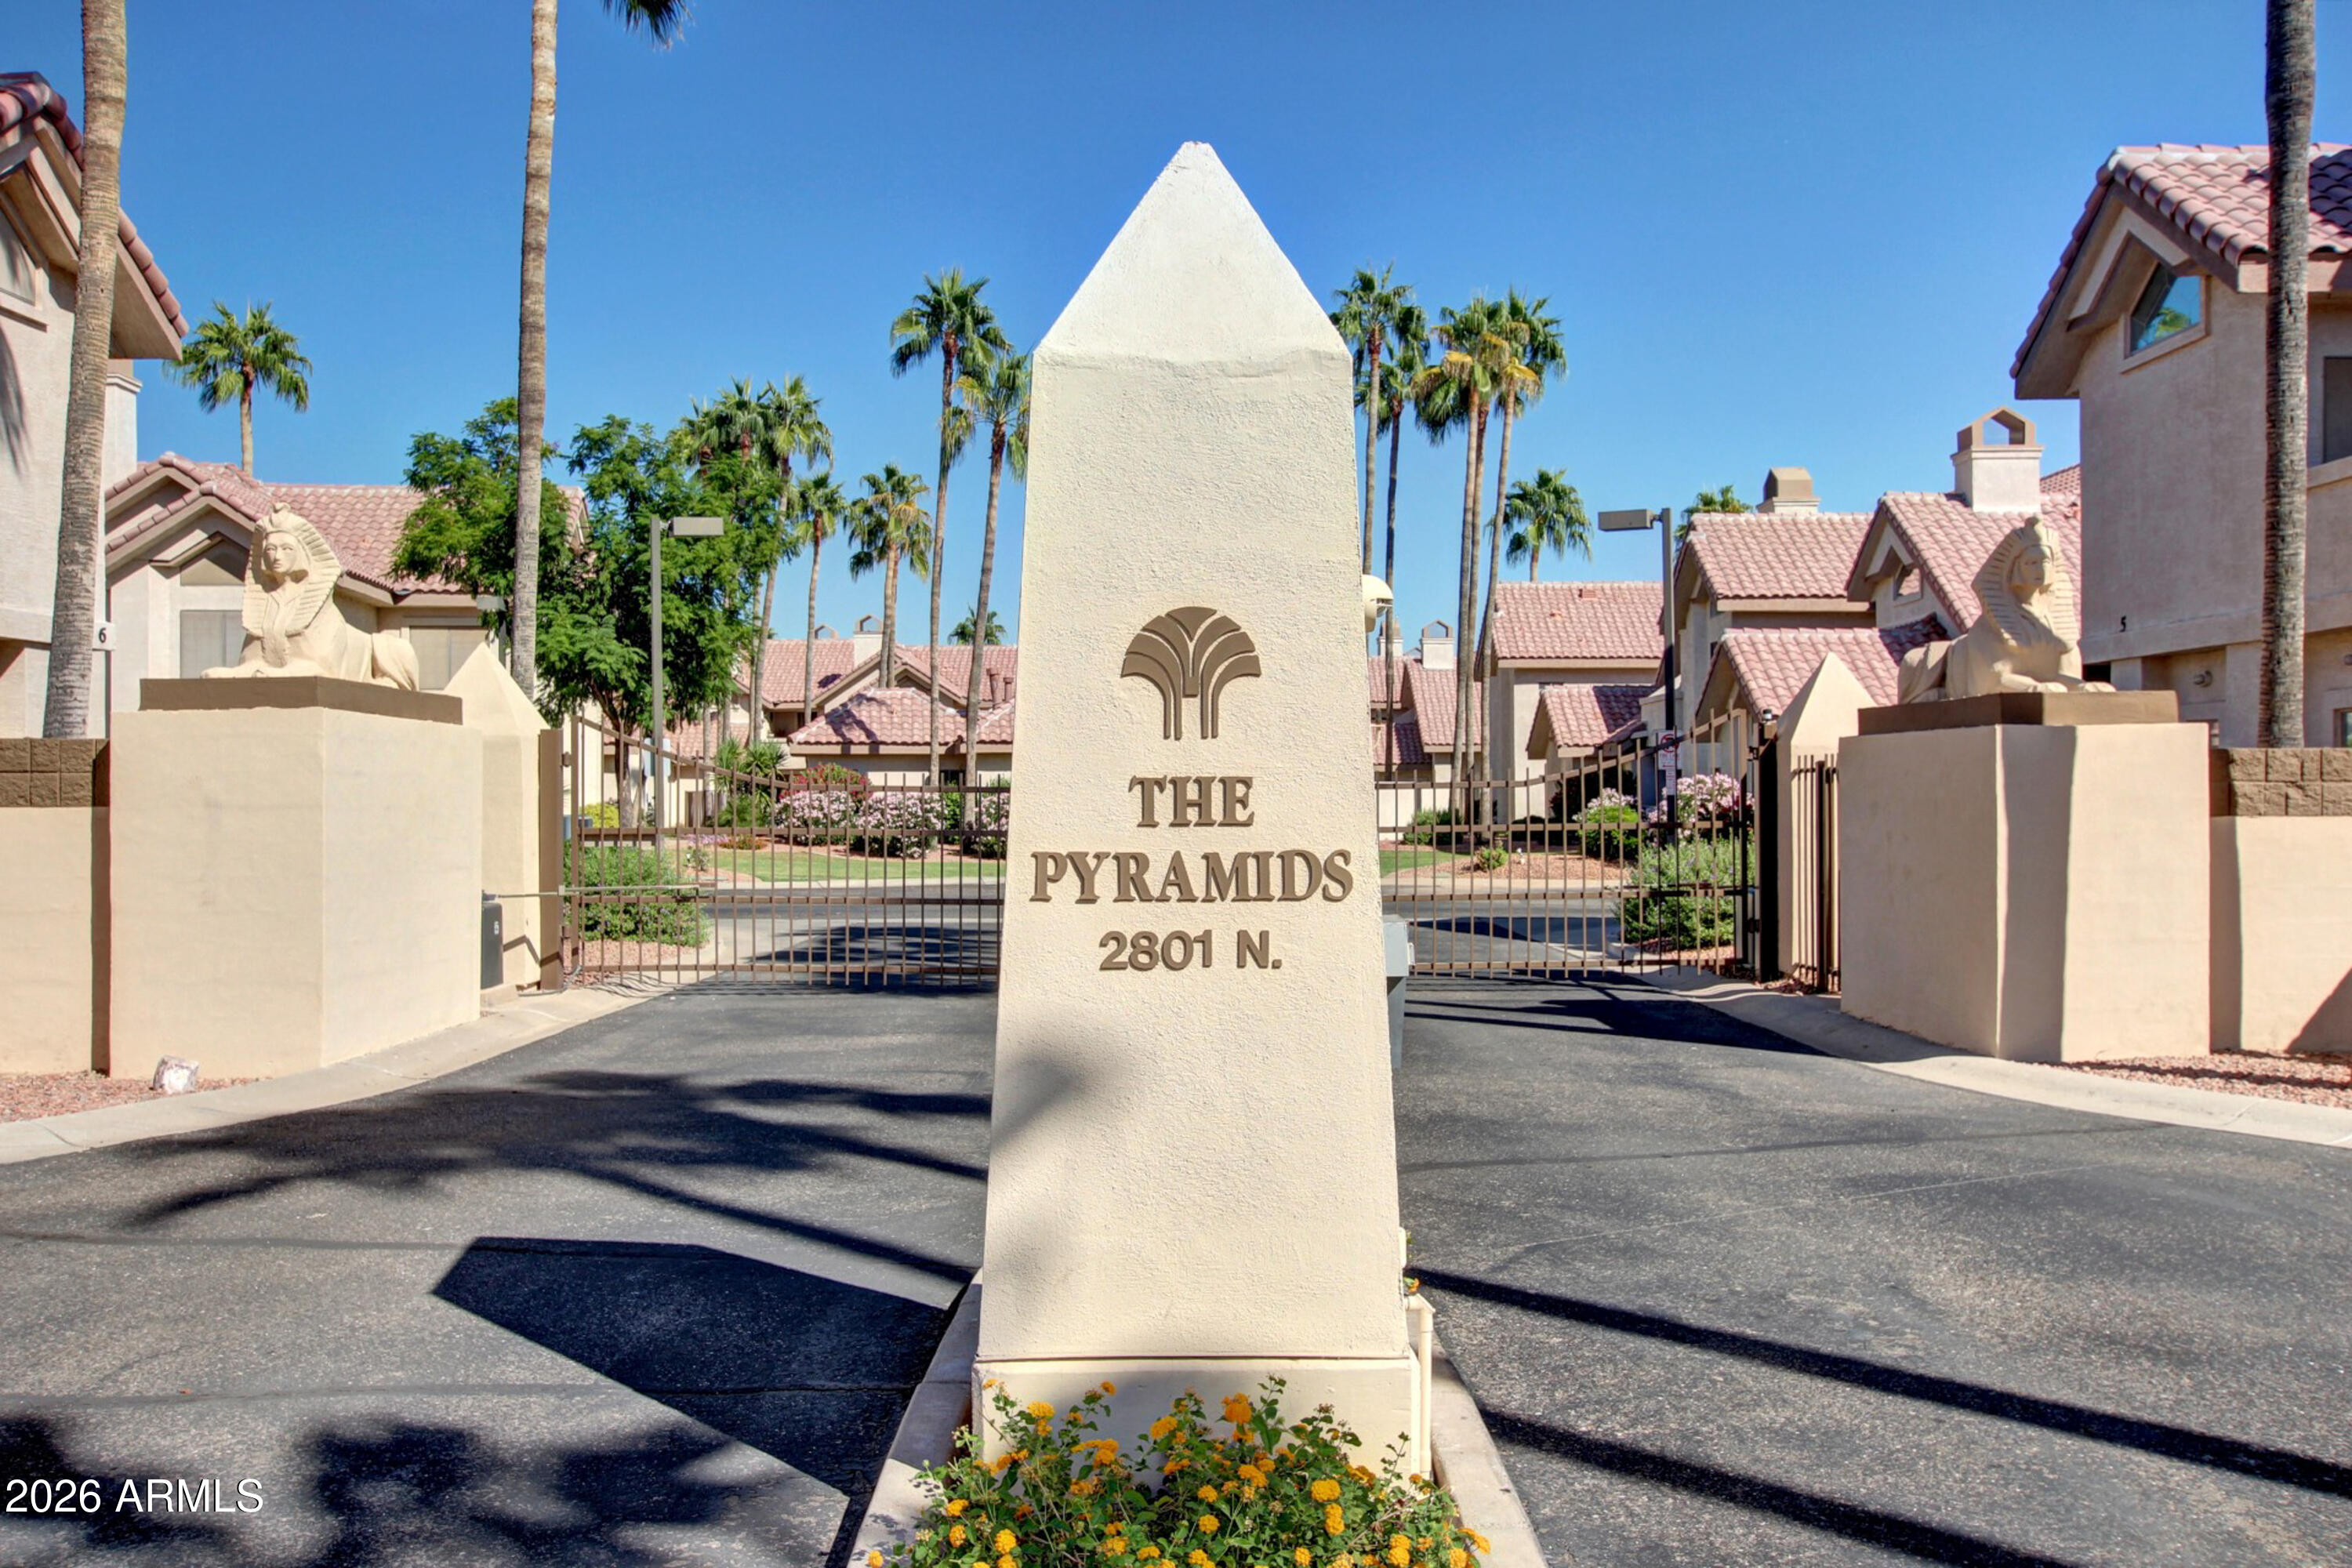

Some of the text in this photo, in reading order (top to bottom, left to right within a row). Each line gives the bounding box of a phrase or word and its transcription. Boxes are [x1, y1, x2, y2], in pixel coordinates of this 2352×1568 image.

[98, 627, 107, 643] 6
[1129, 775, 1254, 827] THE
[1029, 849, 1353, 904] PYRAMIDS
[1099, 930, 1282, 971] 2801 N.
